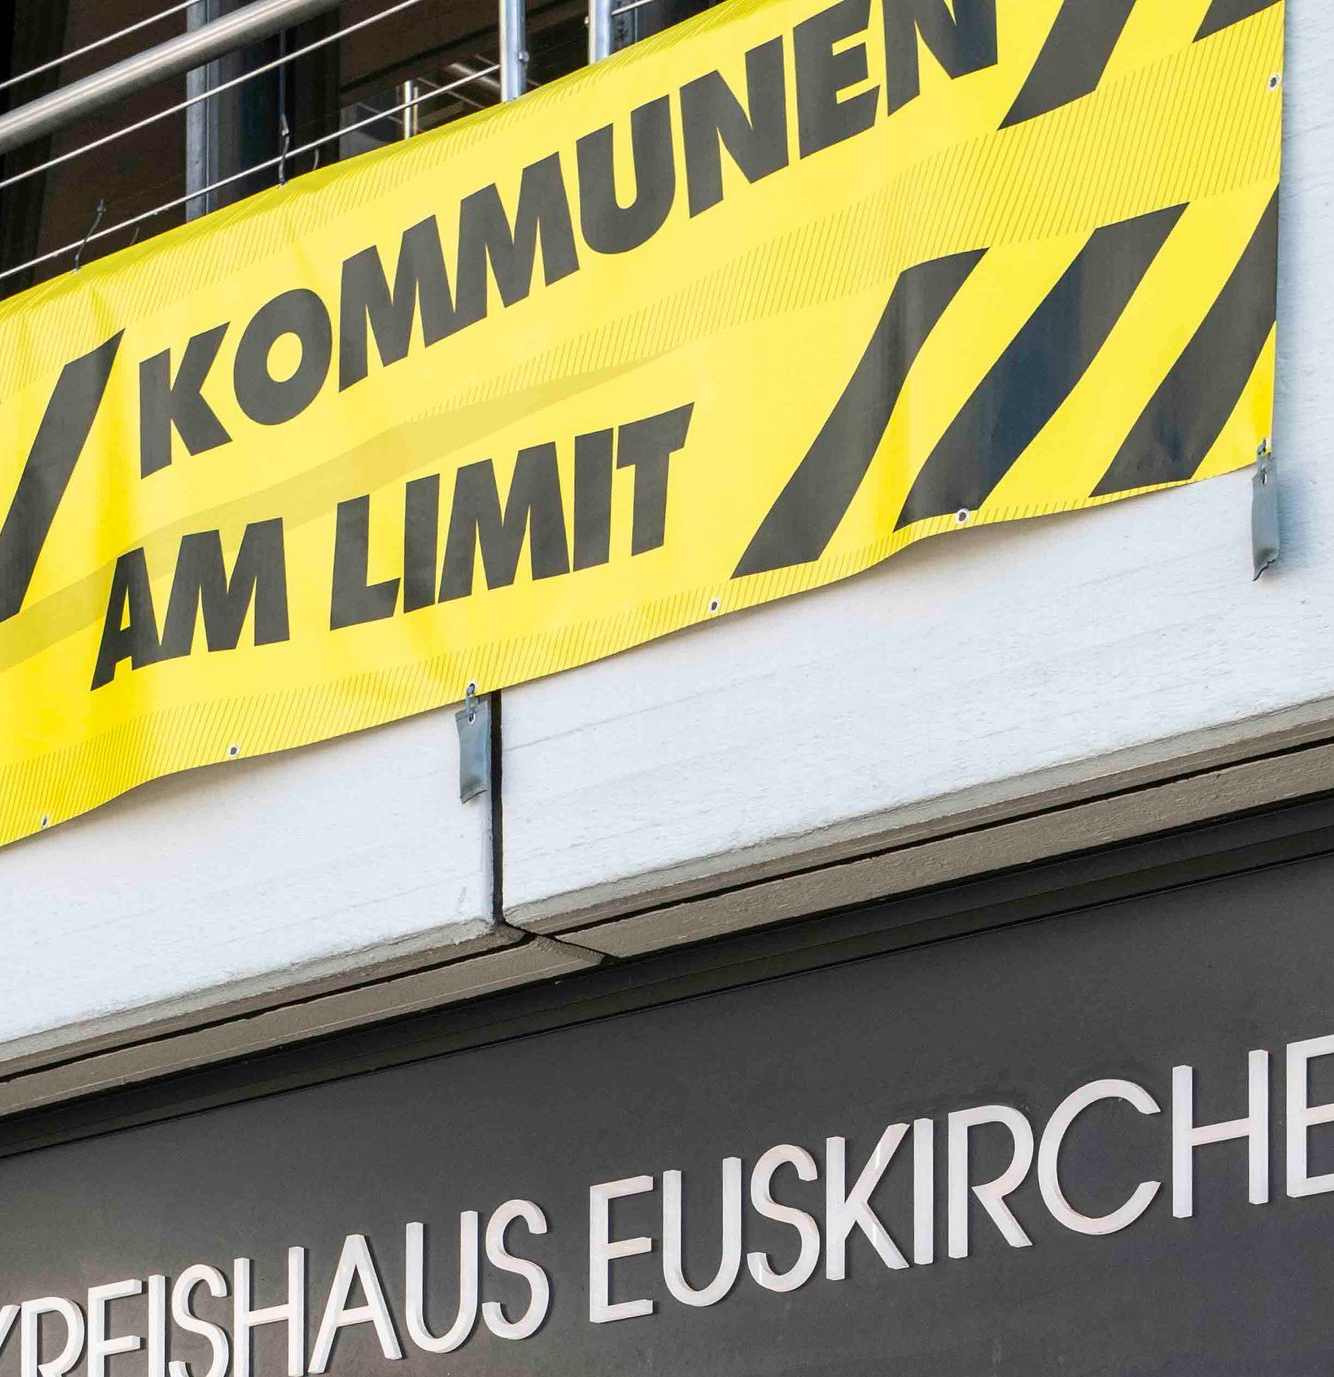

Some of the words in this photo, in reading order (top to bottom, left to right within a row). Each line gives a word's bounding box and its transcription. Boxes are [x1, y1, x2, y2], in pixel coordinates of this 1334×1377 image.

[139, 0, 998, 480] KOMMUNEN
[90, 516, 290, 691] AM
[329, 402, 695, 631] LIMIT
